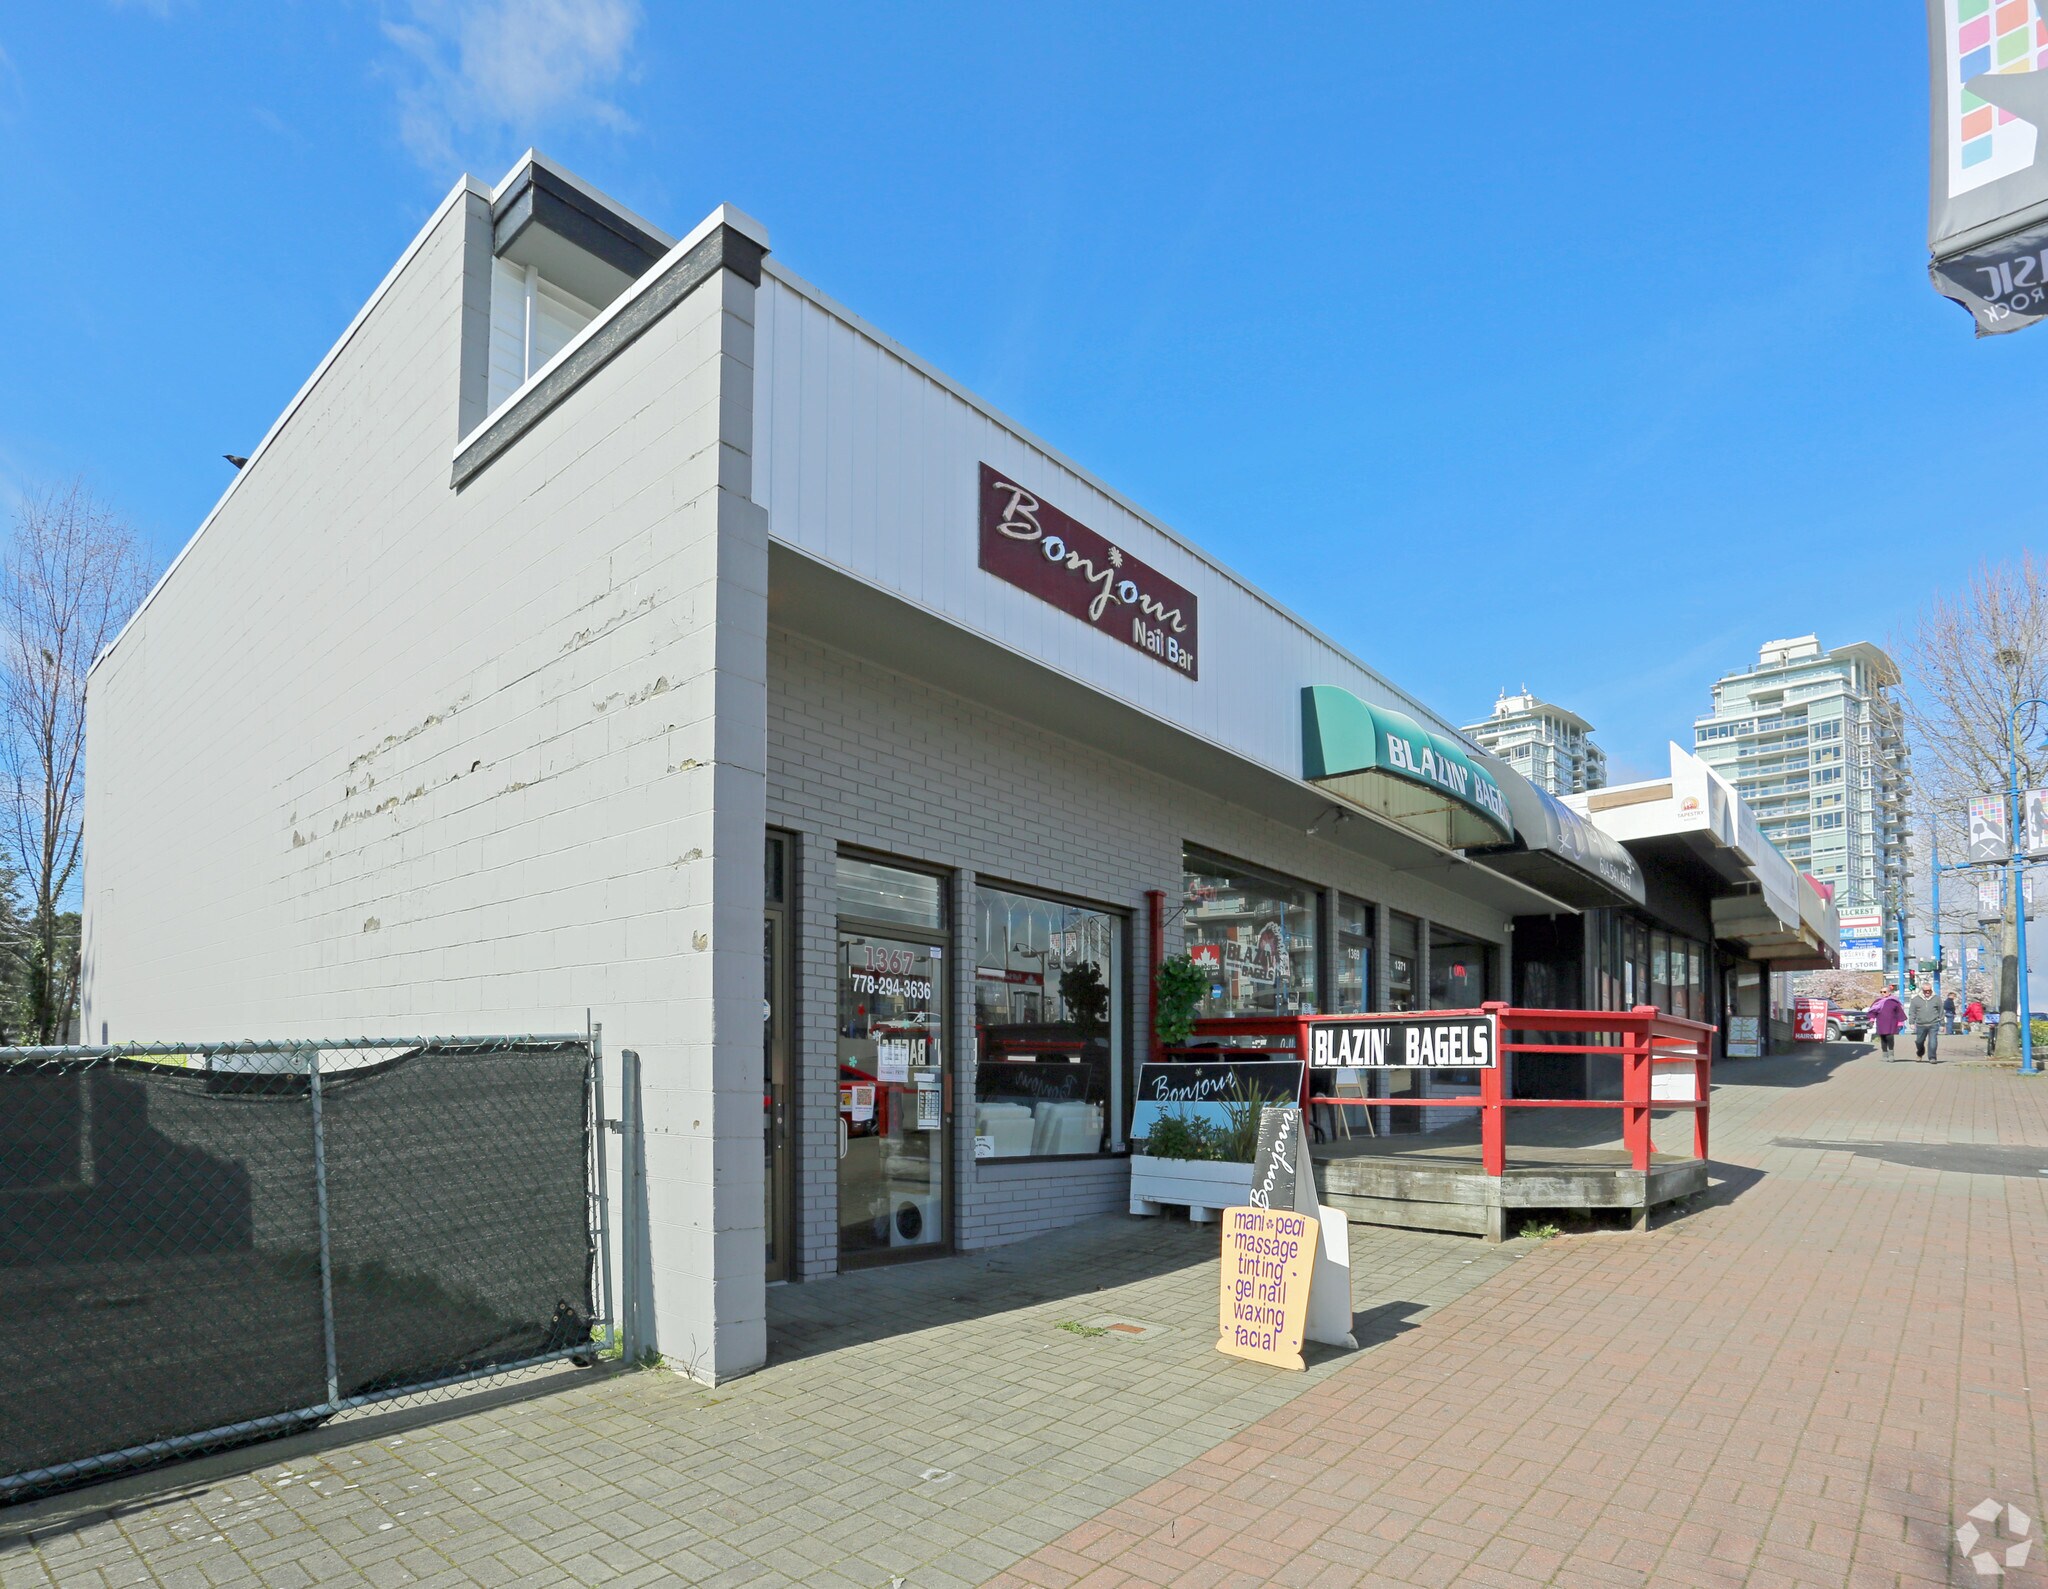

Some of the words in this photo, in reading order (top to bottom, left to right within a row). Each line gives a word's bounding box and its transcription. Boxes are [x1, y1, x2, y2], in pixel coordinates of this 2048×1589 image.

[992, 481, 1188, 633] Bonjour
[1133, 617, 1165, 657] Nail
[1166, 637, 1194, 671] Bar
[1386, 732, 1469, 796] BLAZIN'
[1677, 810, 1705, 818] TAPESTRY
[865, 945, 914, 976] 1367
[1394, 960, 1406, 972] 1371
[852, 974, 931, 1000] 778-294-3636
[1314, 1028, 1391, 1066] BLAZIN'
[1405, 1025, 1488, 1066] BAGELS
[1152, 1068, 1237, 1103] Bonjour
[1250, 1109, 1295, 1211] Bonjour
[1234, 1210, 1266, 1231] mani
[1234, 1232, 1299, 1265] massage
[1238, 1252, 1285, 1287] tinting
[1235, 1276, 1255, 1302] gel
[1259, 1281, 1287, 1305] nail
[1233, 1301, 1285, 1333] waxing
[1235, 1325, 1279, 1353] facial
